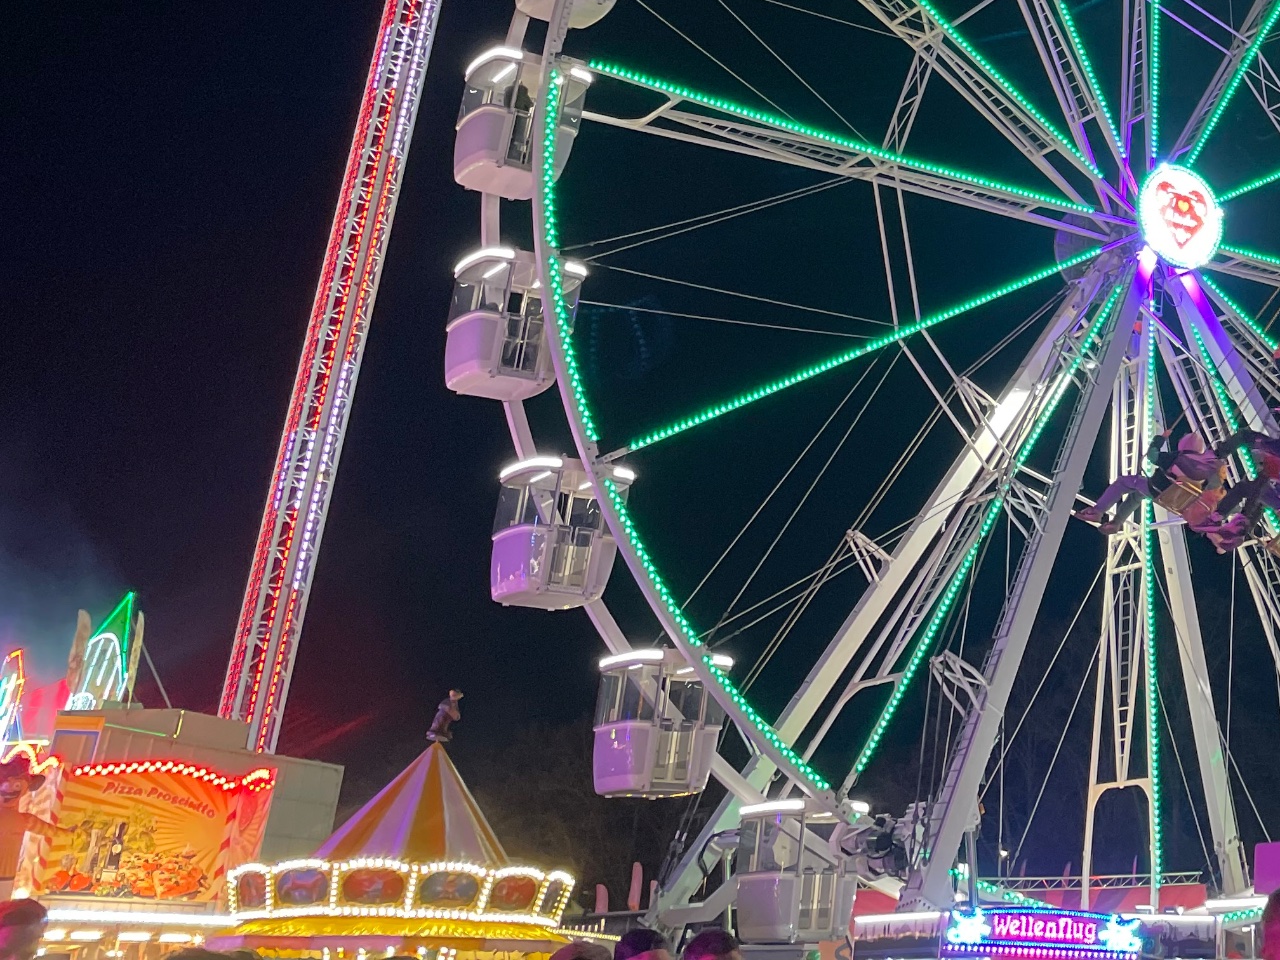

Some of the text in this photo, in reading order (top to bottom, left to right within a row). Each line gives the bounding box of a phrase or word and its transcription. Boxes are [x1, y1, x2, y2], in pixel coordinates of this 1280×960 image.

[102, 782, 215, 819] Pizza Prosciutto
[994, 915, 1096, 944] Wellenflug
